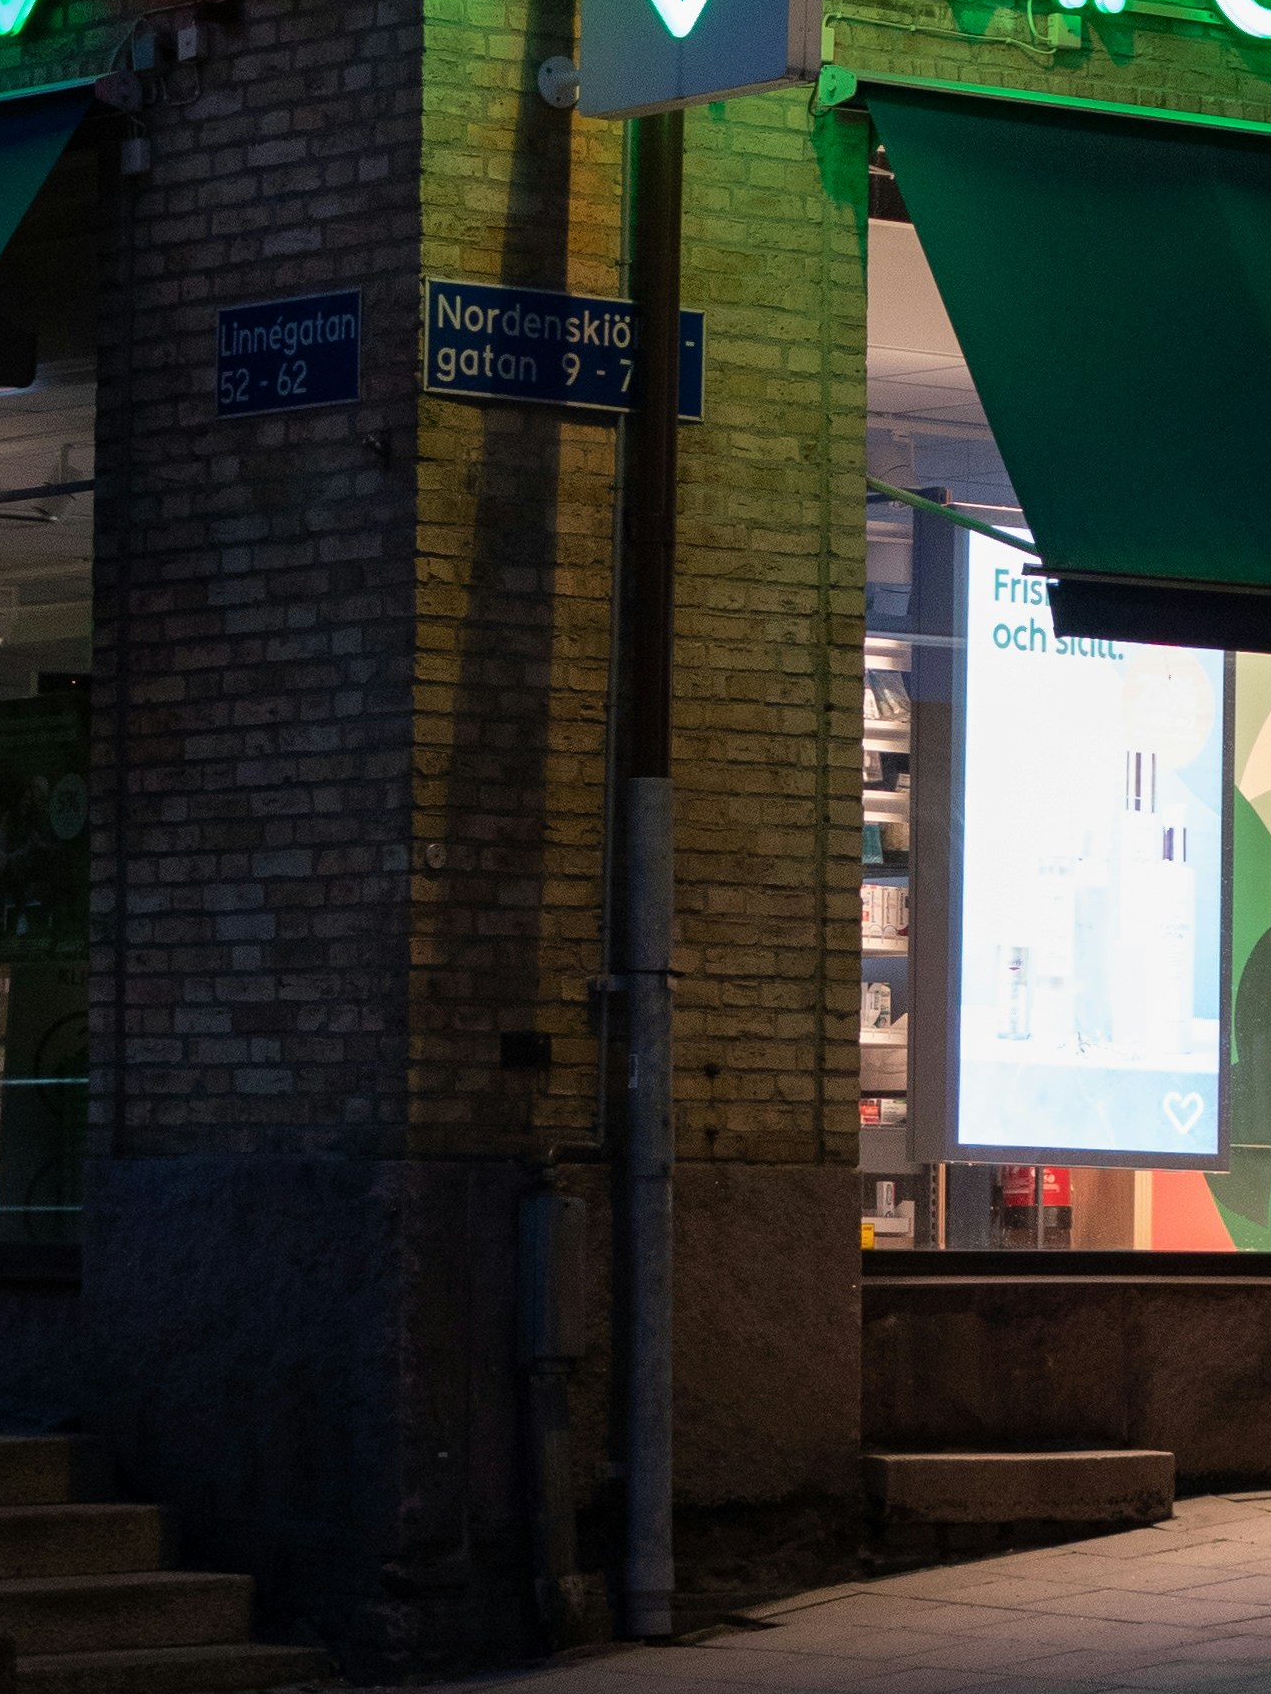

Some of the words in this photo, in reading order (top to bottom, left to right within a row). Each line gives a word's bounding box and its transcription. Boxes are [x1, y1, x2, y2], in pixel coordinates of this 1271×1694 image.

[220, 311, 356, 358] Linnégatan
[220, 368, 251, 405] 52
[276, 360, 308, 397] 62
[436, 344, 537, 384] gatan
[561, 352, 581, 387] 9
[995, 567, 1051, 606] Fris
[992, 617, 1047, 654] och
